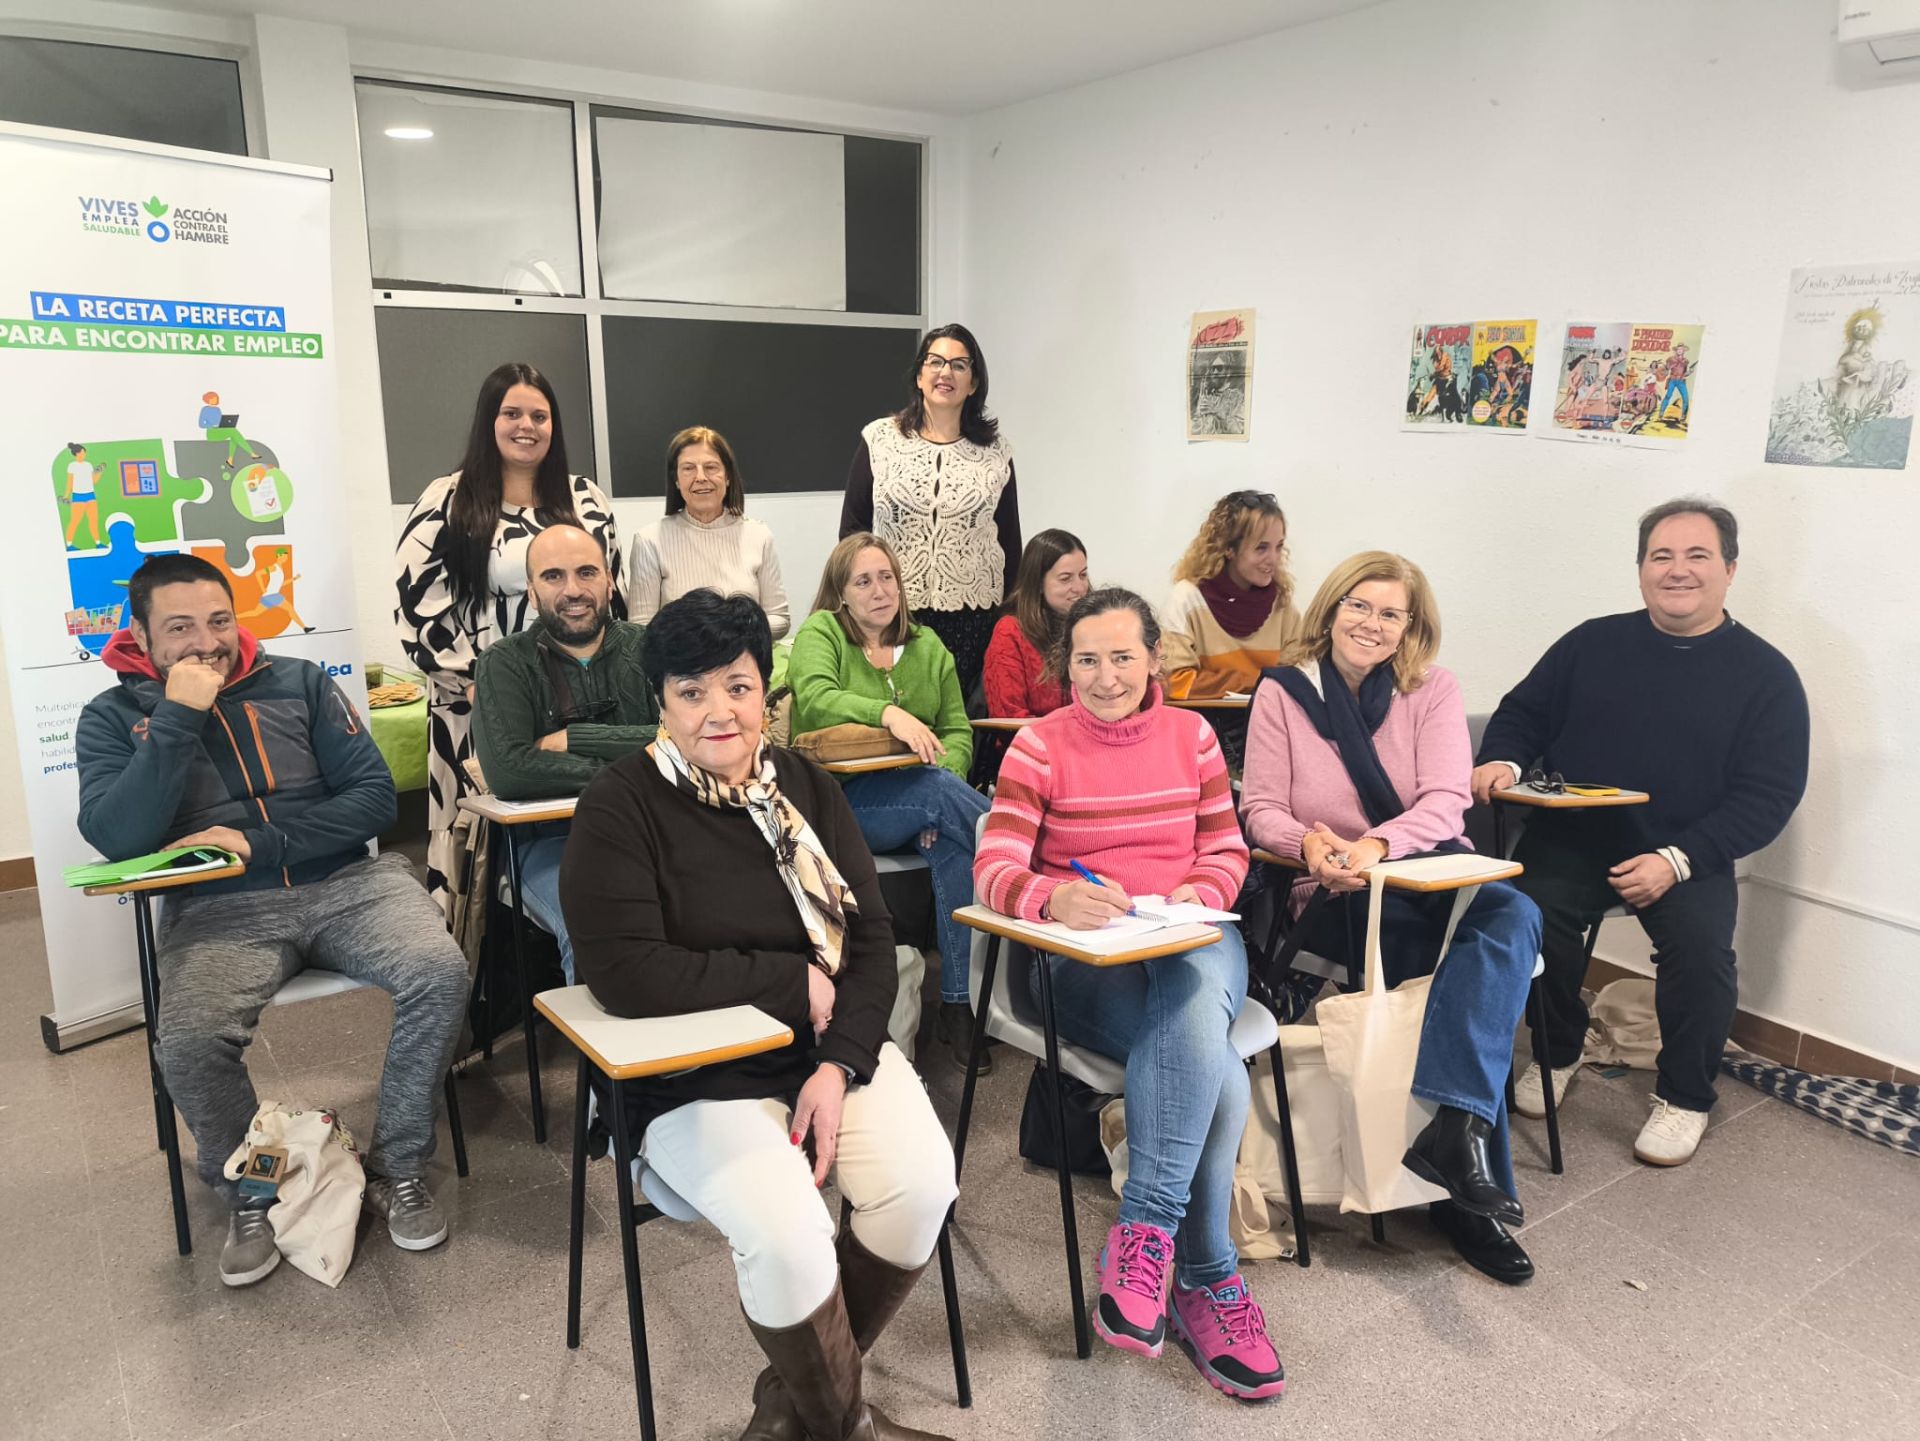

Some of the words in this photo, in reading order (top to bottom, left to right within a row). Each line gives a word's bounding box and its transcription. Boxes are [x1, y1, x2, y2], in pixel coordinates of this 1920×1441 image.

[78, 196, 139, 217] VIVES
[82, 212, 139, 226] EMPLEA
[173, 208, 228, 224] ACCIÓN
[83, 223, 141, 236] SALUDABLE
[173, 220, 216, 233] CONTRA
[217, 225, 228, 233] EL
[174, 230, 229, 244] HAMBRE
[35, 296, 70, 318] LA
[78, 299, 168, 322] RECETA
[175, 305, 282, 328] PERFECTA
[75, 327, 227, 352] ENCONTRAR
[233, 334, 320, 355] EMPLEO
[320, 661, 352, 677] lea
[37, 718, 76, 729] encontr
[39, 732, 69, 743] salud
[41, 746, 77, 758] habilid
